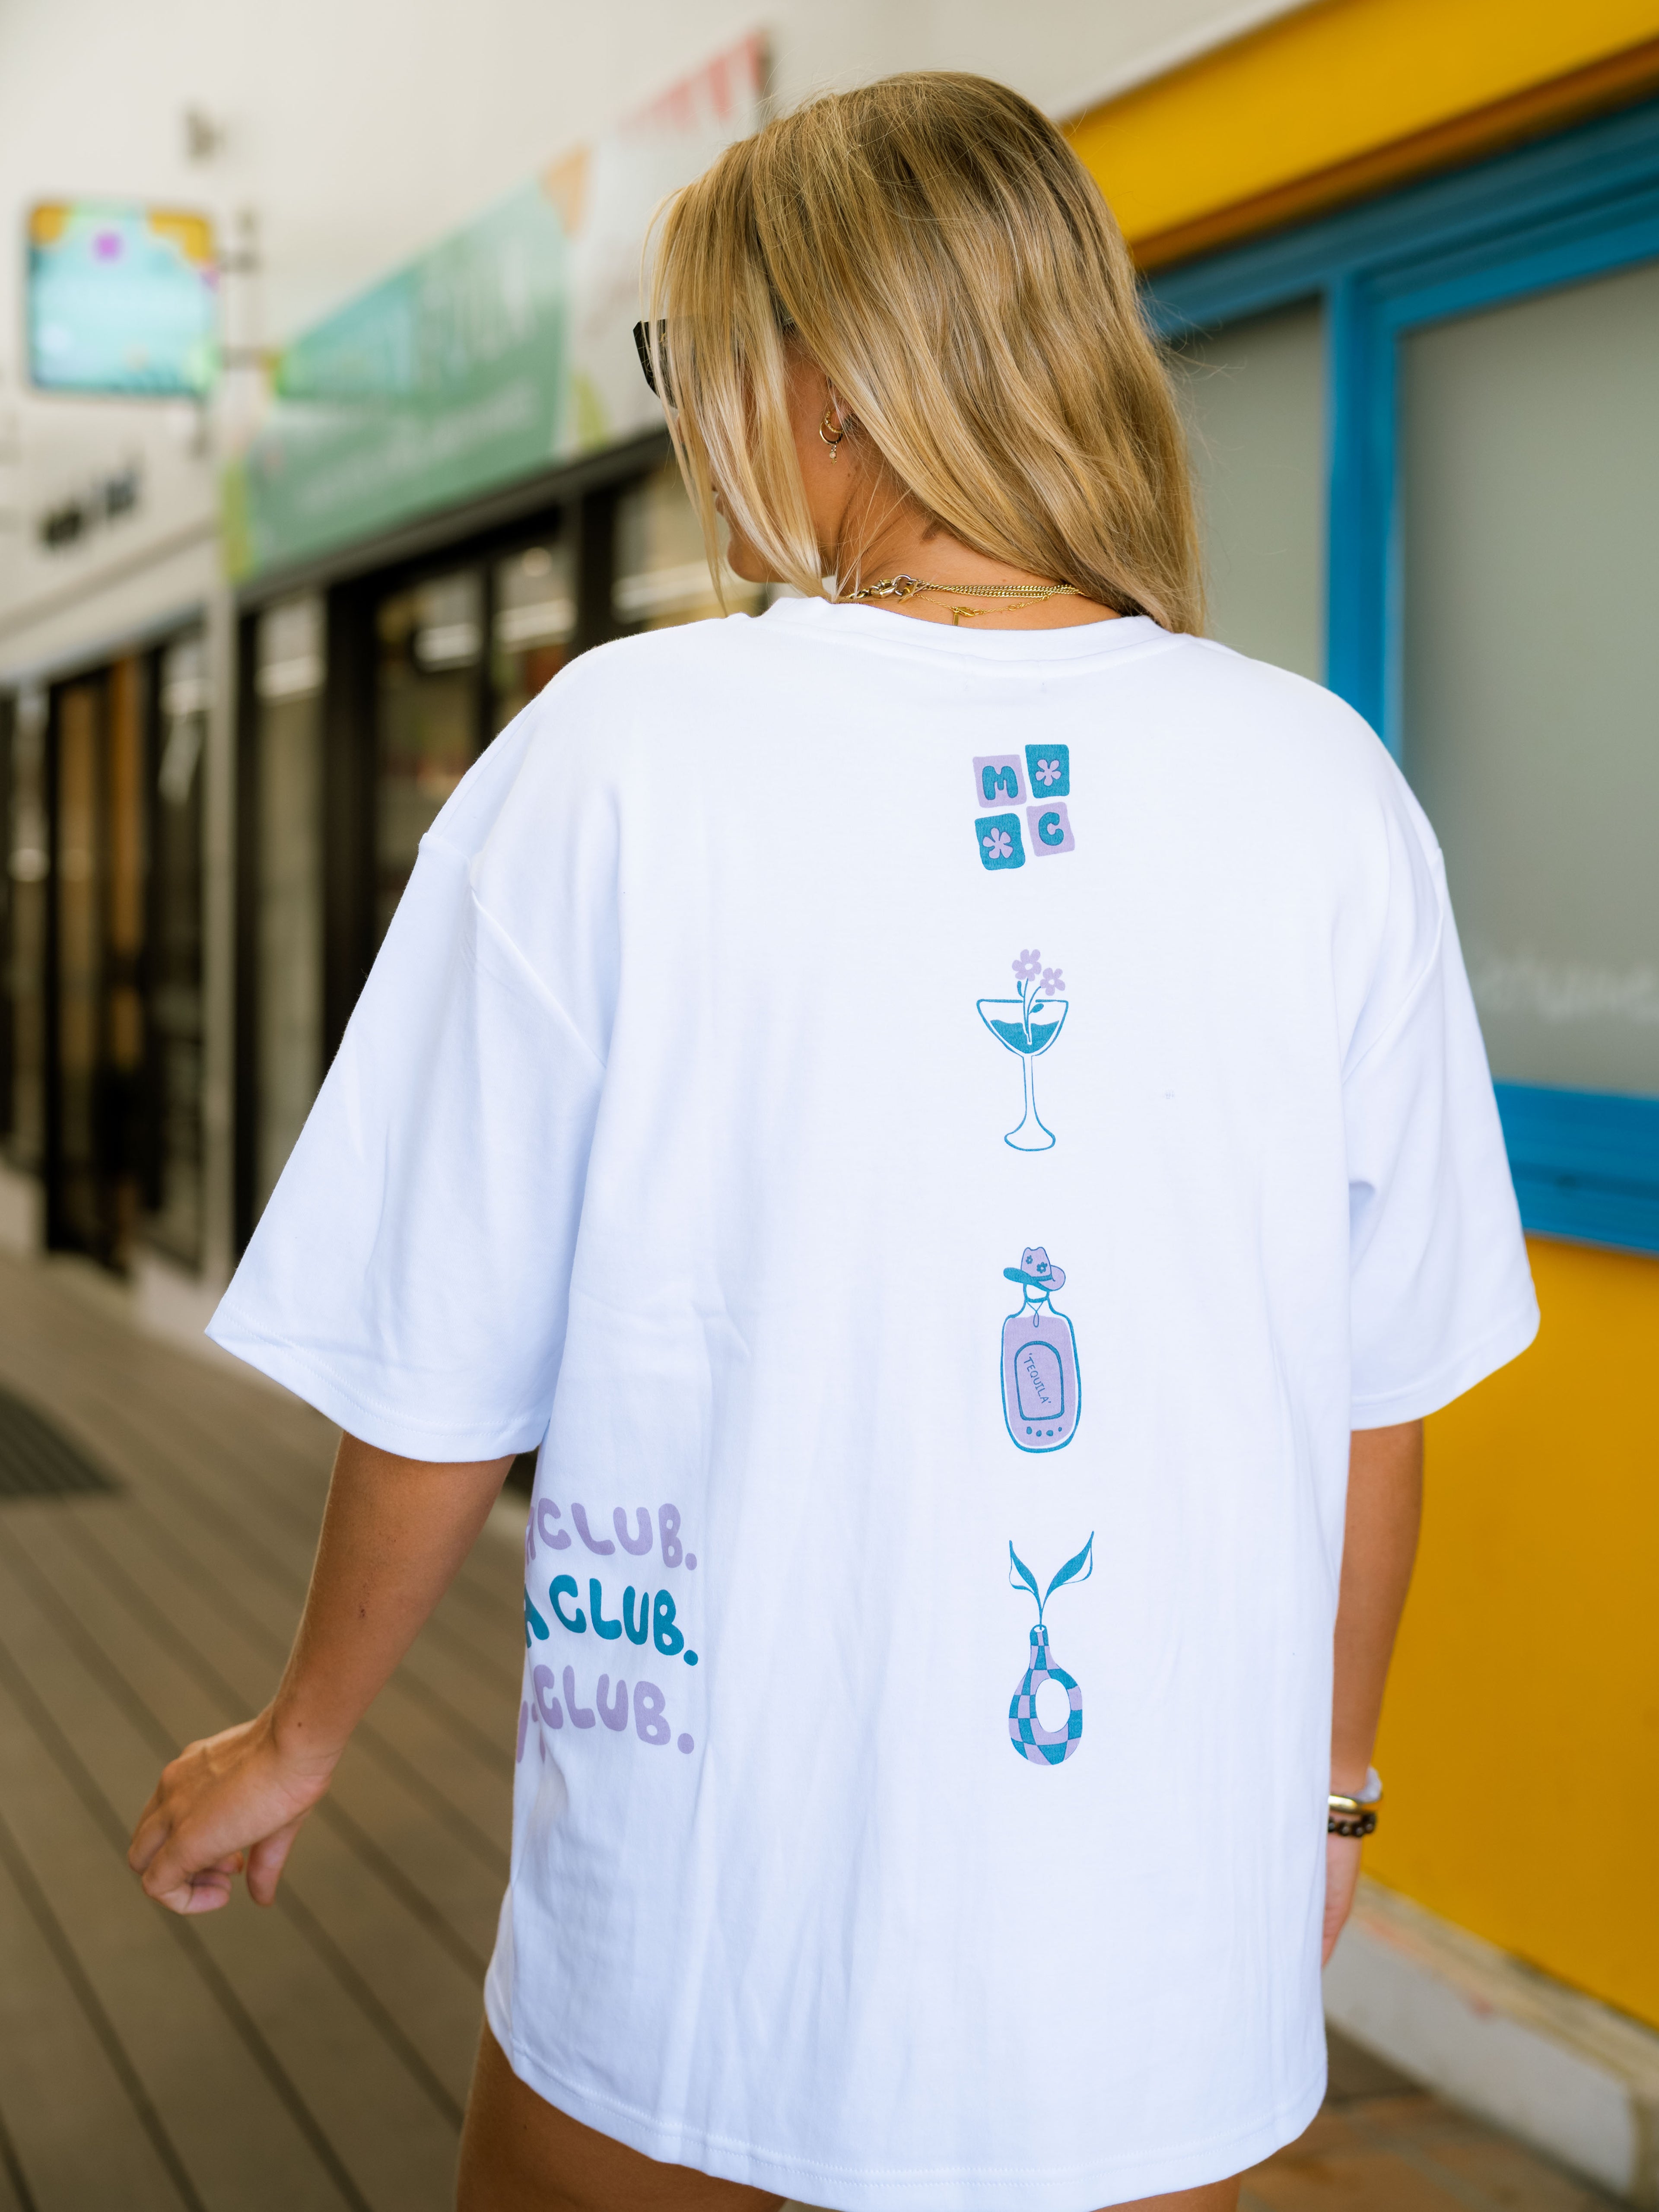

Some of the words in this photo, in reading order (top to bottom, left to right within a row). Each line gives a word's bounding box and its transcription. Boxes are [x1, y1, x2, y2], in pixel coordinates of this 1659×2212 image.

[537, 1497, 698, 1570] CLUB.
[549, 1574, 698, 1666] CLUB.
[533, 1664, 695, 1754] CLUB.
